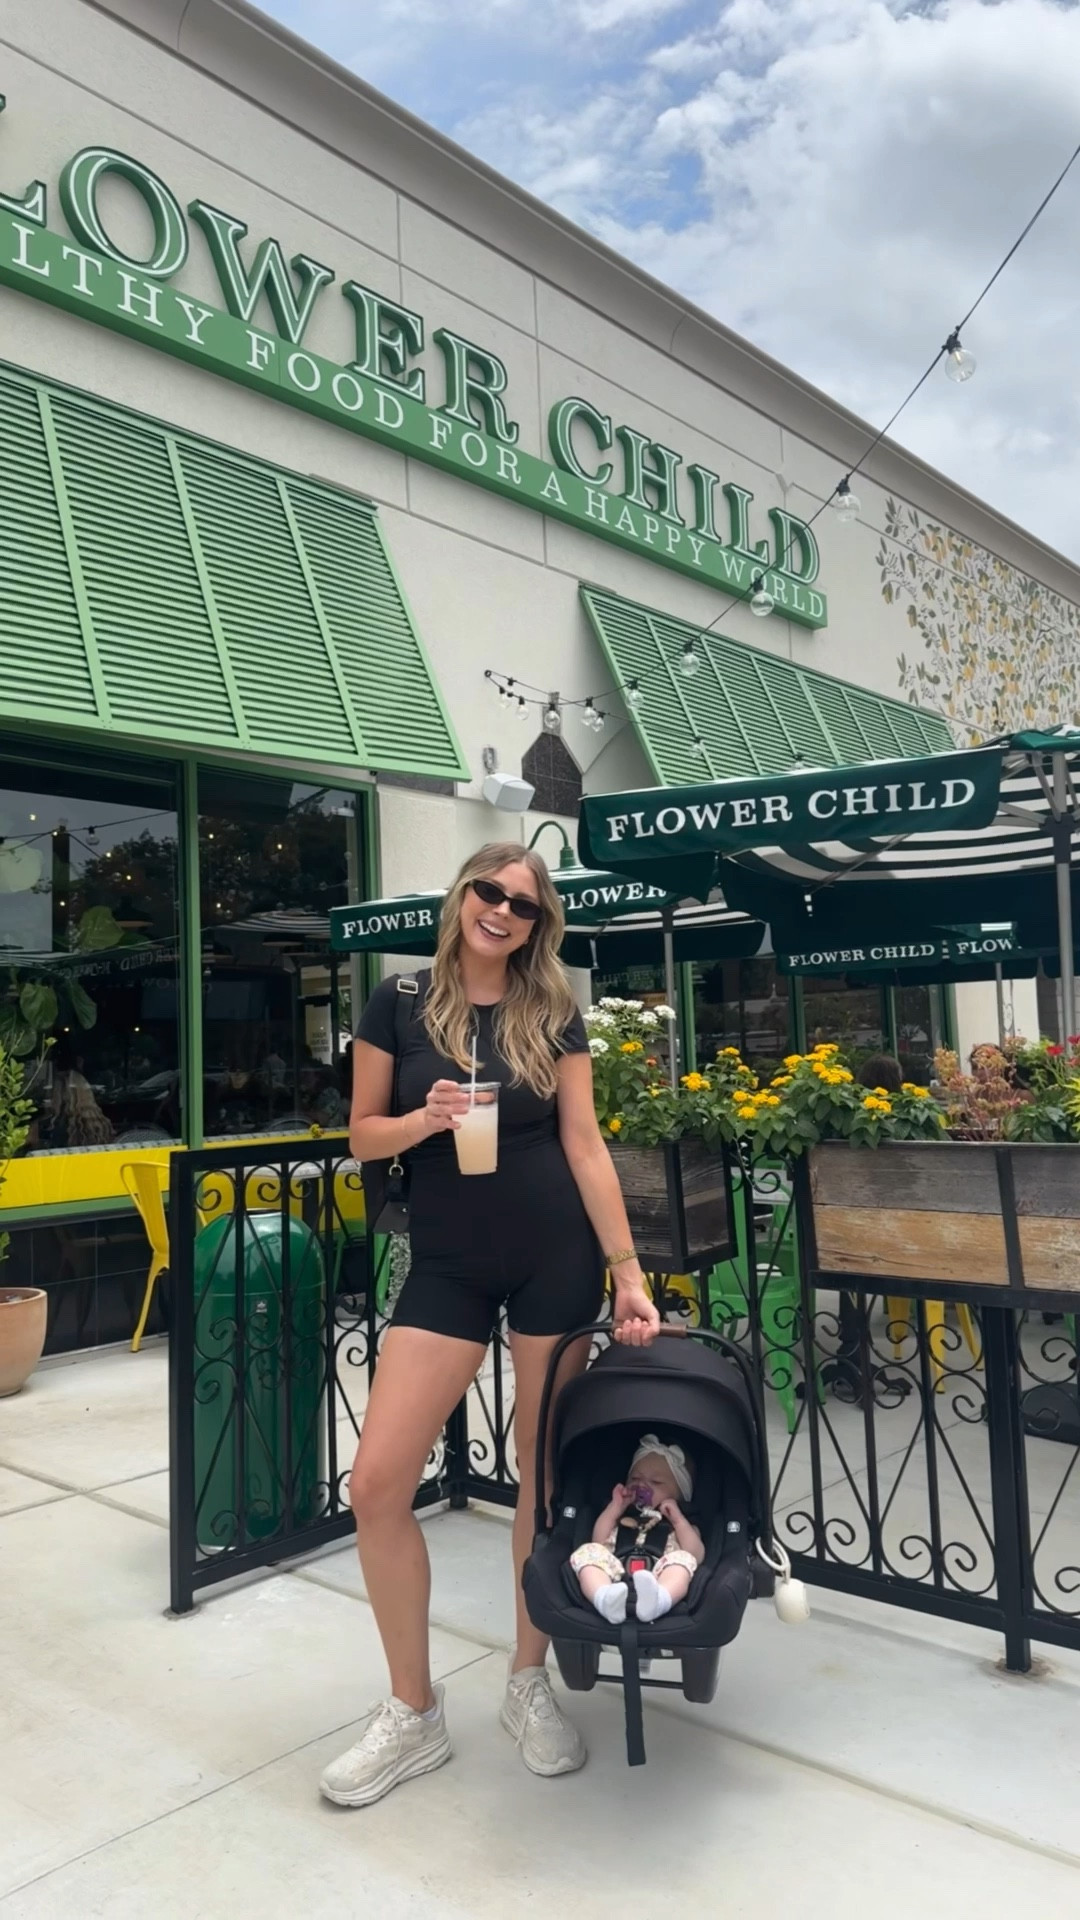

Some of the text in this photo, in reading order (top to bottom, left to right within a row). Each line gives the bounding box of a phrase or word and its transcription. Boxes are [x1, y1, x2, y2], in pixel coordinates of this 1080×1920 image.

[12, 222, 824, 618] LTHY FOOD FOR A HAPPY WORLD
[548, 396, 820, 585] CHILD
[606, 778, 976, 842] FLOWER CHILD
[342, 908, 434, 939] FLOWER
[788, 944, 936, 967] FLOWER CHILD
